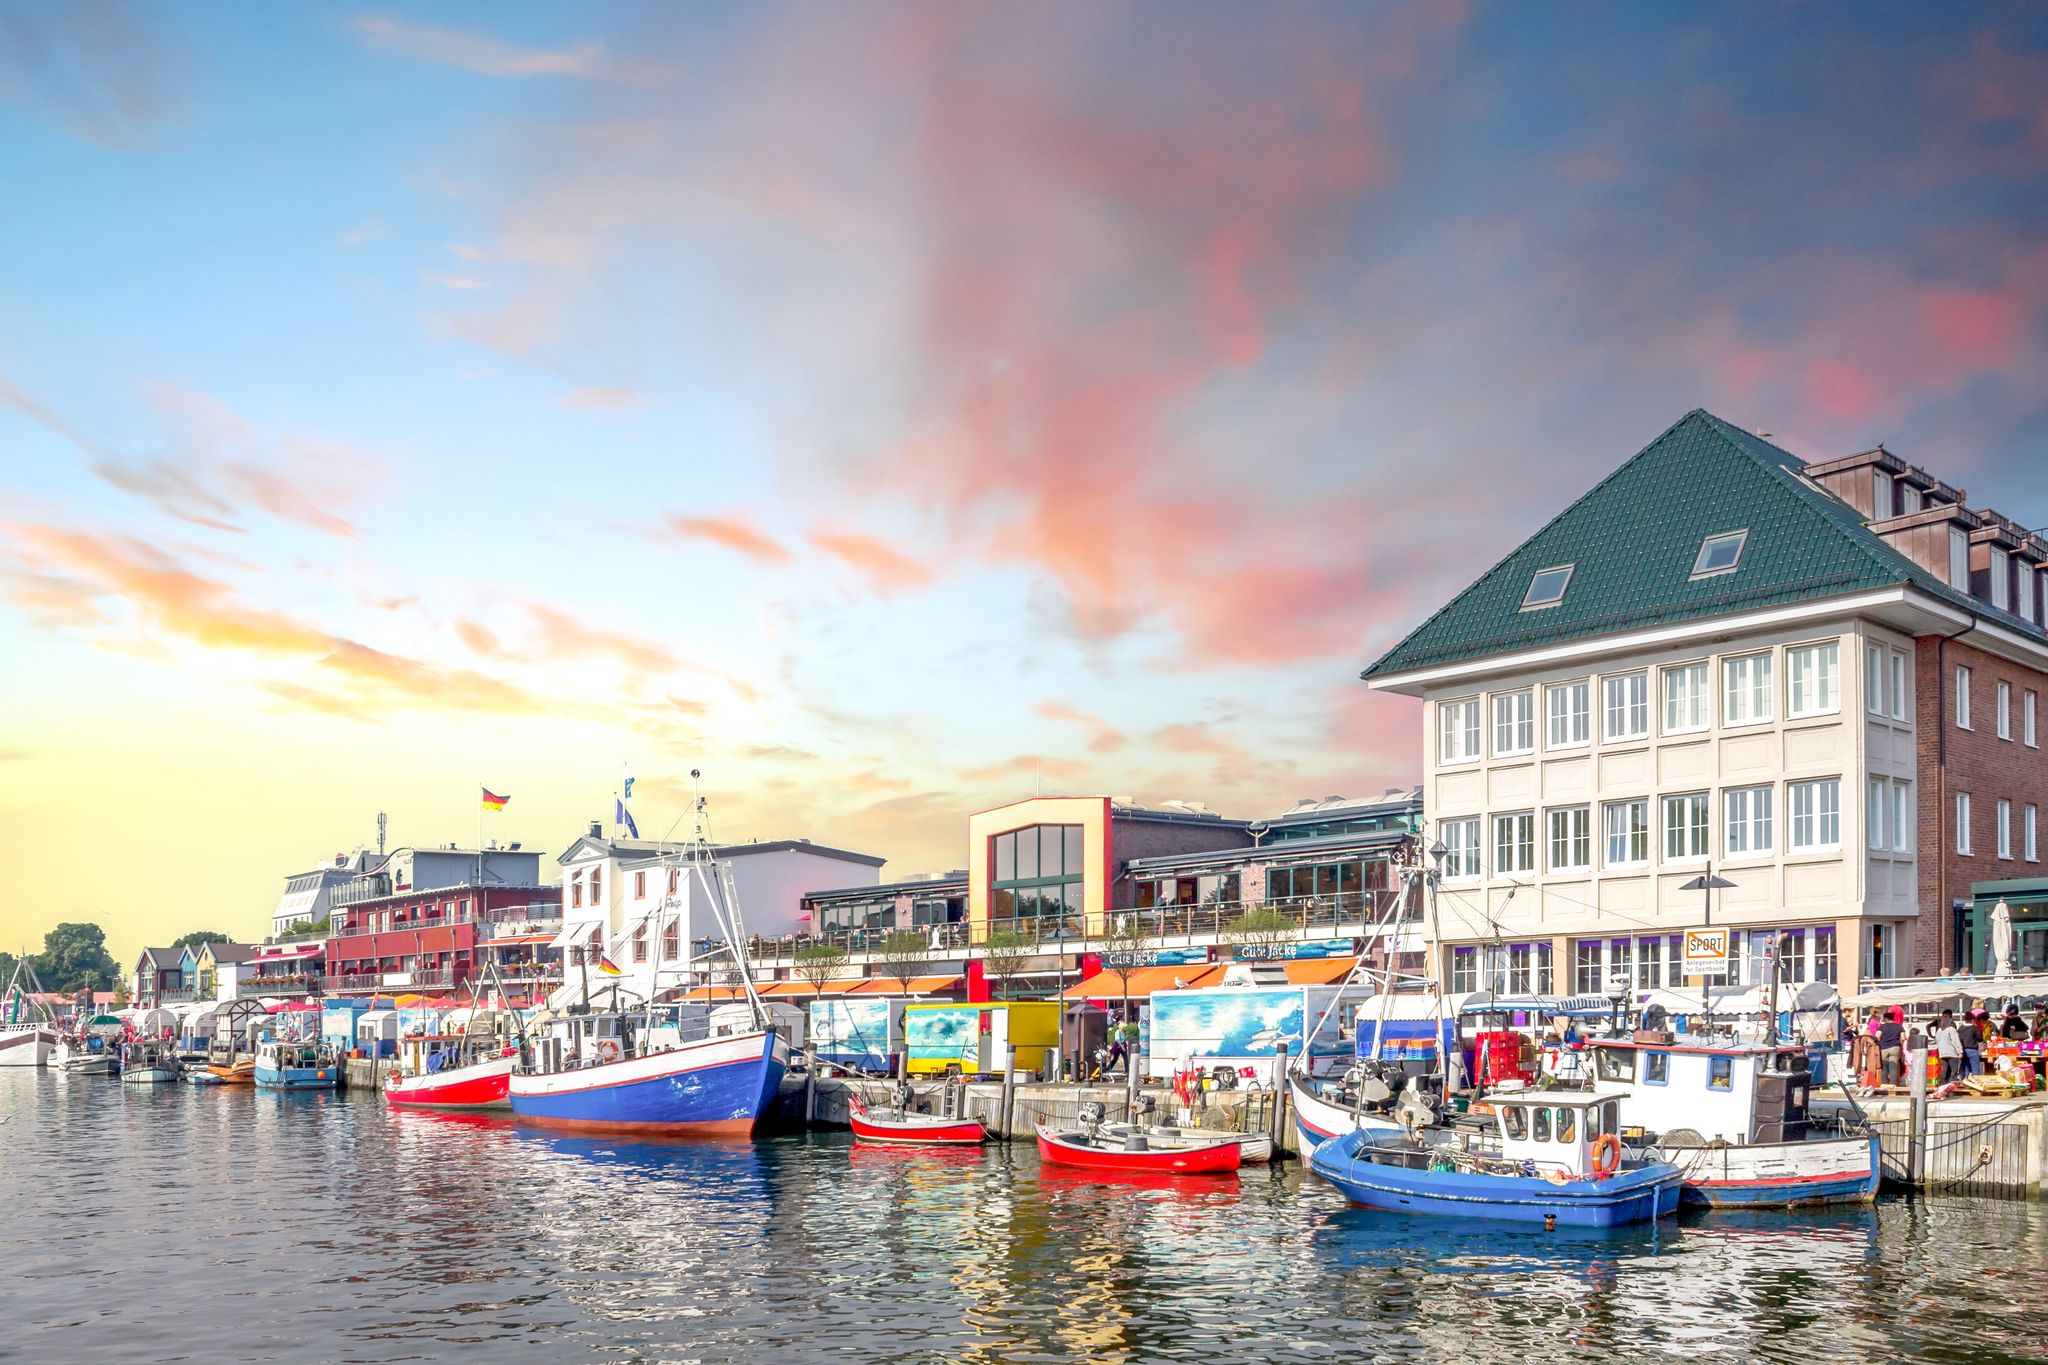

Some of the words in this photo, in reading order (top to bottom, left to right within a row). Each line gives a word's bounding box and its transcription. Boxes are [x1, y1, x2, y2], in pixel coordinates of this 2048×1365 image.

[1241, 945, 1266, 958] Gute
[1267, 943, 1297, 959] Jacke
[1690, 938, 1722, 951] SPORT
[1133, 951, 1158, 966] Jacke
